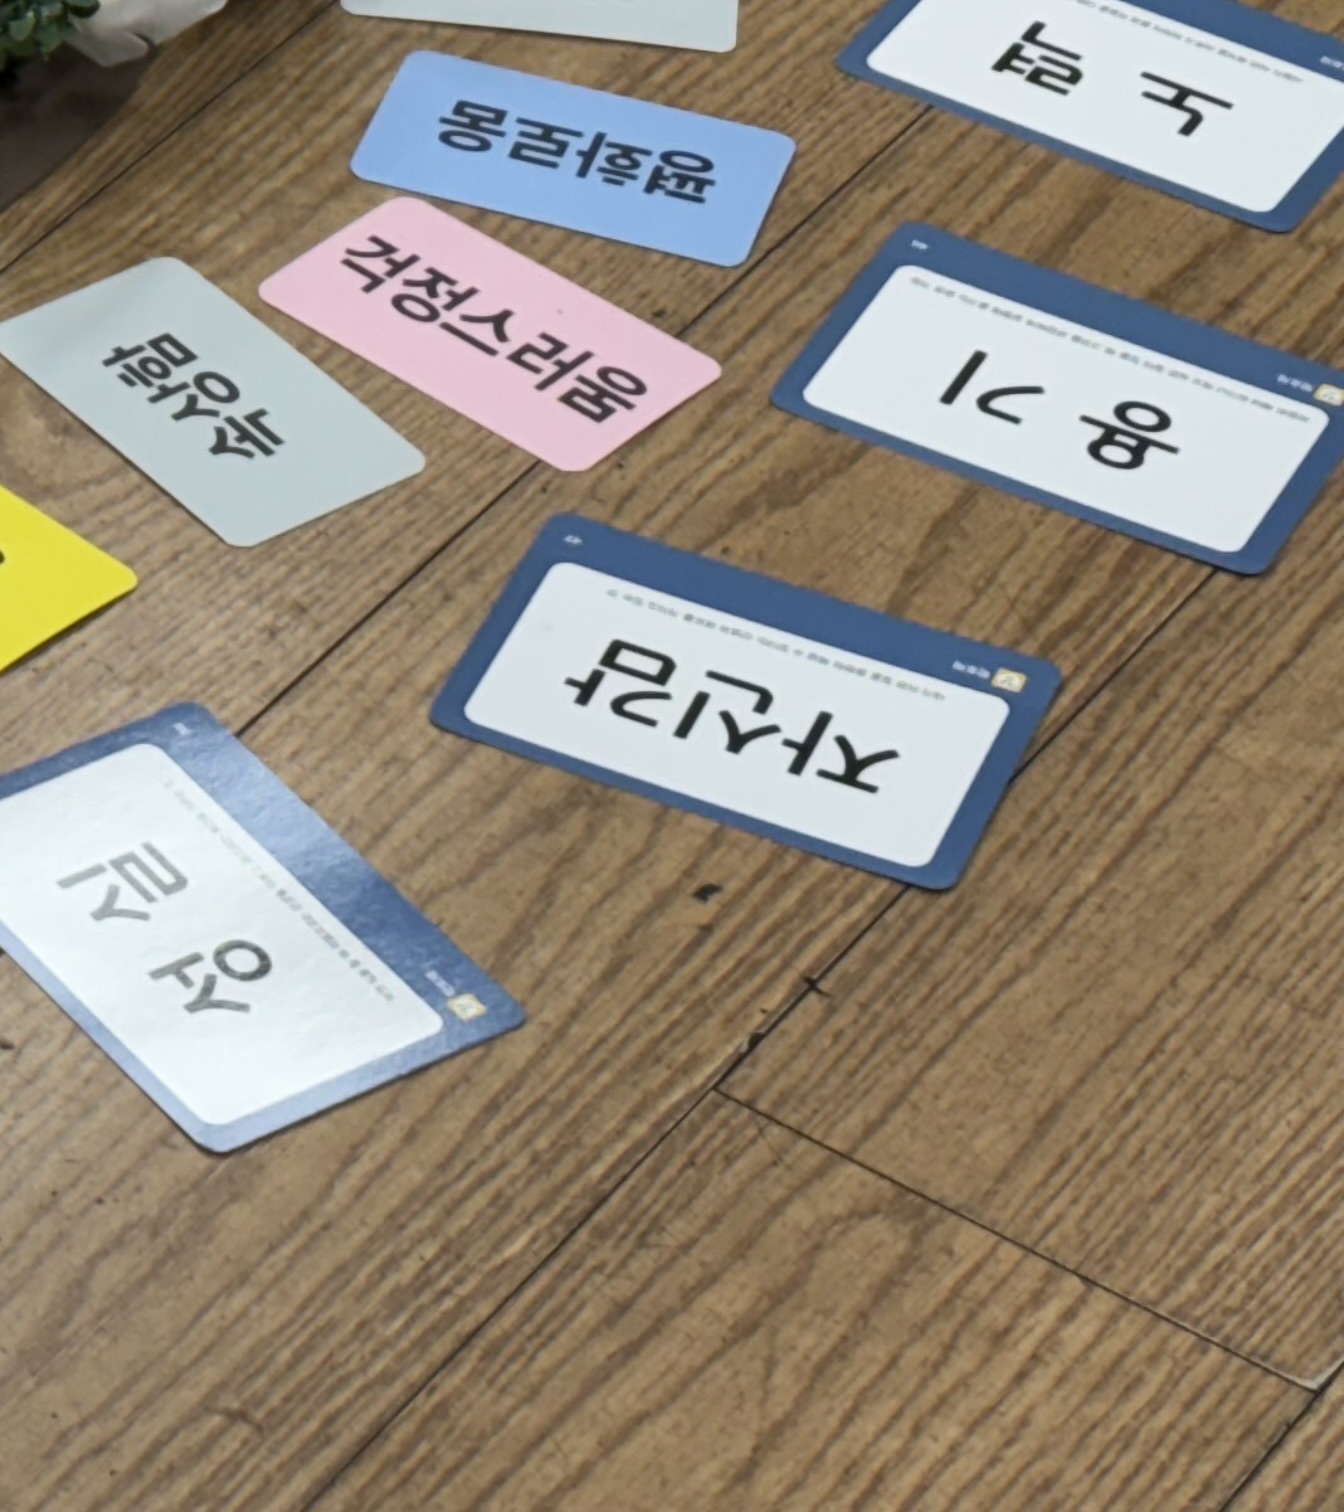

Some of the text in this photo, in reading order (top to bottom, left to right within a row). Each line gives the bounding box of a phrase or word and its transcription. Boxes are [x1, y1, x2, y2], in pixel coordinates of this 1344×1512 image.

[437, 97, 717, 205] 평화로움
[102, 332, 284, 459] 속상함
[342, 236, 649, 424] 걱정스러움
[565, 638, 899, 800] 자신감
